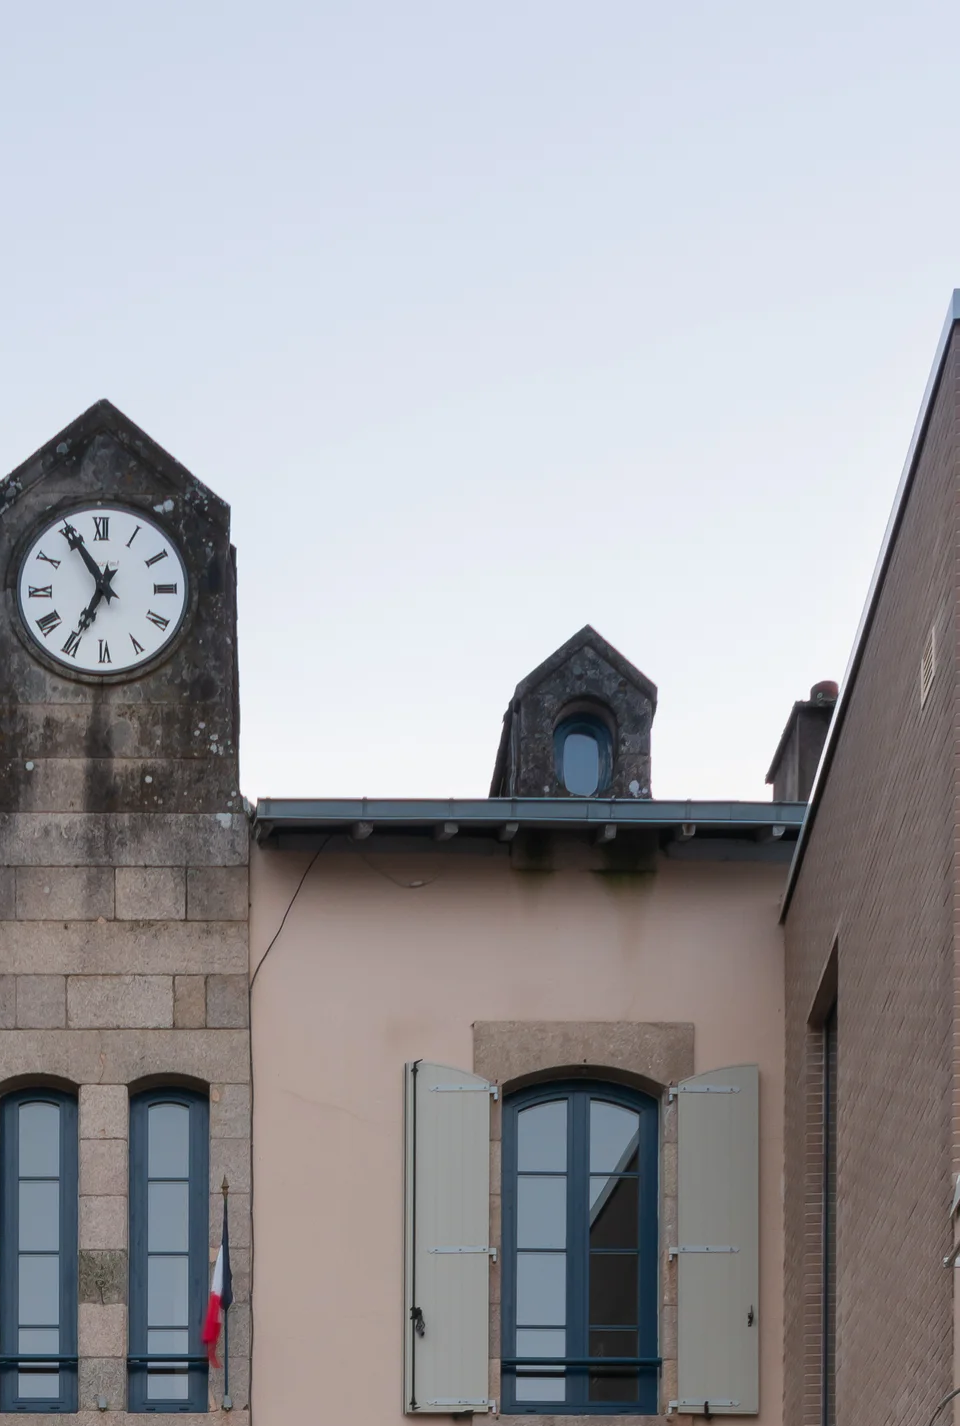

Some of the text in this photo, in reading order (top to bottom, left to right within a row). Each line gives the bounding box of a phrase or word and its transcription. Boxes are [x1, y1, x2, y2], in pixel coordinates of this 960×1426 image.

[92, 516, 110, 541] XII
[36, 550, 61, 570] X
[144, 549, 168, 568] II
[28, 584, 52, 598] IX
[153, 582, 177, 595] III
[146, 609, 170, 631] IV
[60, 630, 82, 658] VII
[98, 639, 112, 663] VI
[128, 632, 145, 655] V
